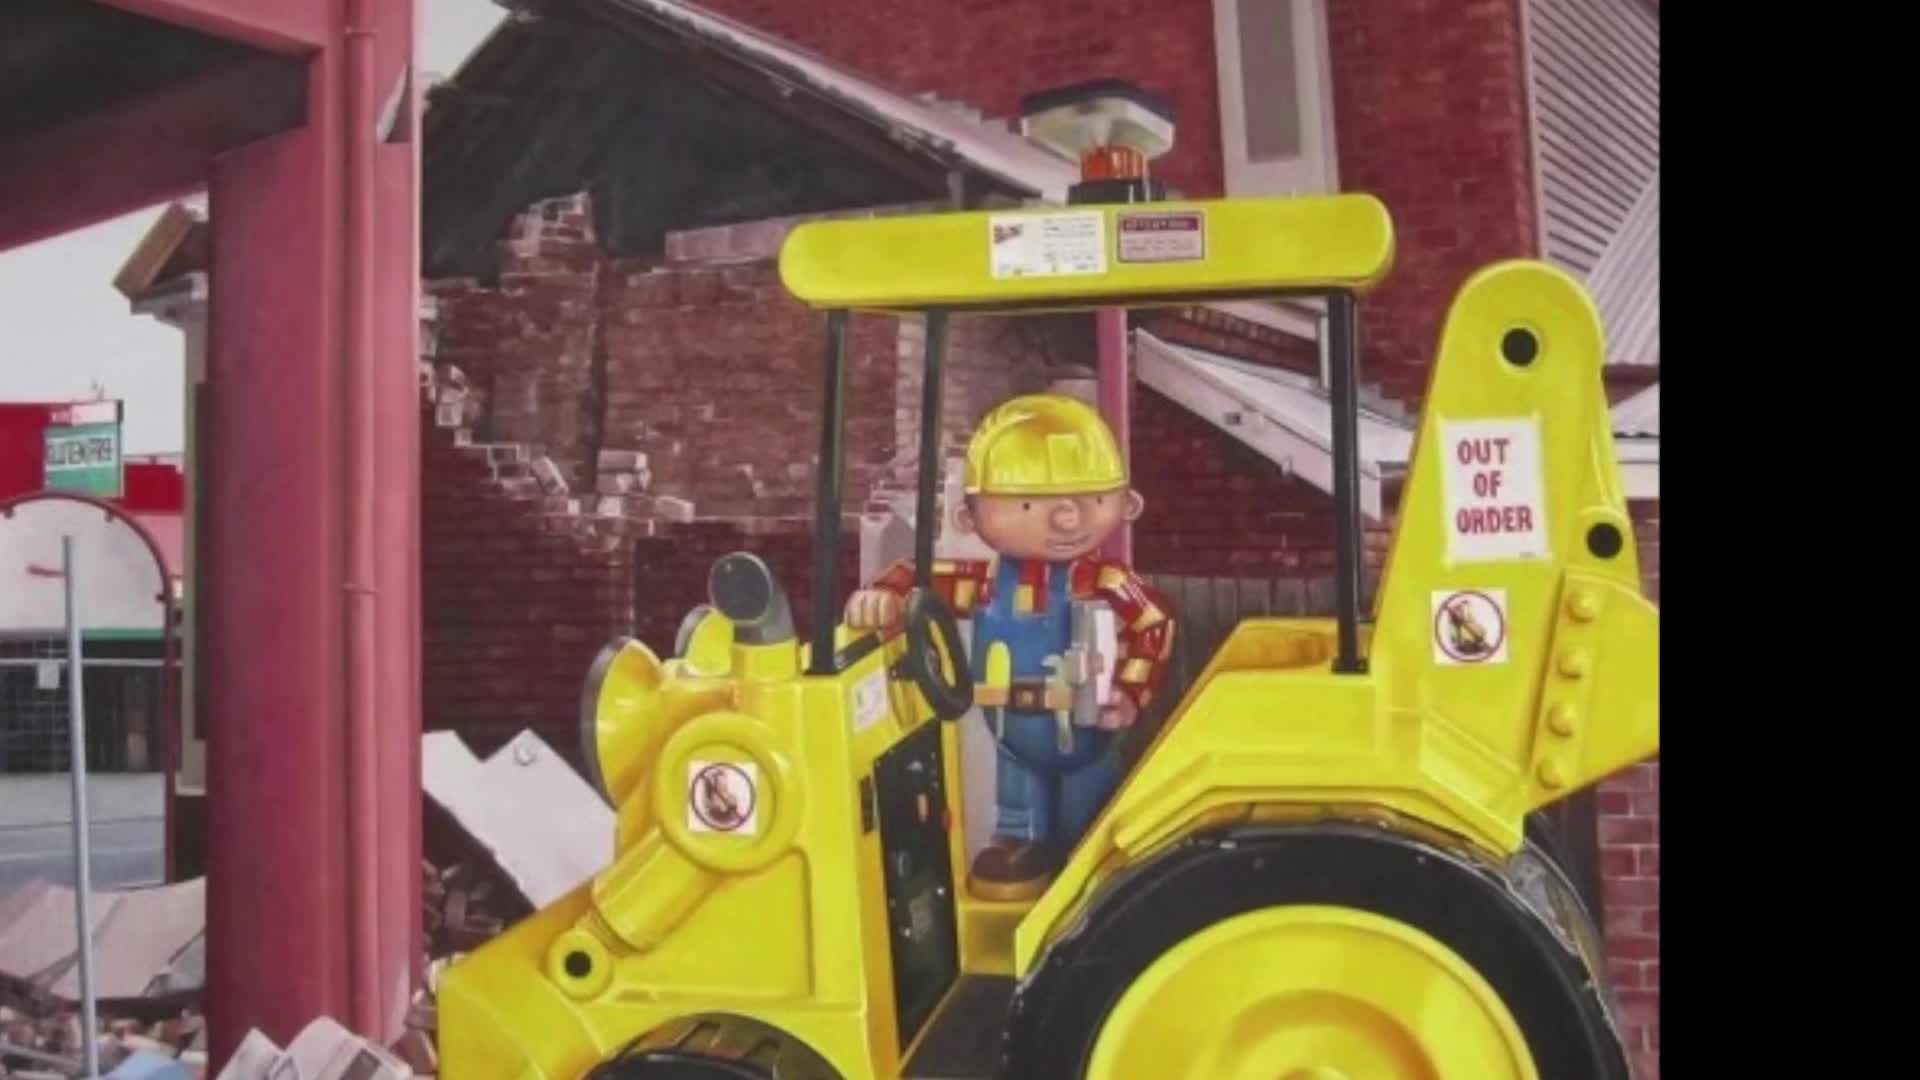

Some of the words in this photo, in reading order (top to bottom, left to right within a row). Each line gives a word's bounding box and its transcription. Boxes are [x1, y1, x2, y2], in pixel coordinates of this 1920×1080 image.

[1456, 437, 1510, 465] OUT
[1473, 470, 1502, 498] OF
[1456, 505, 1533, 534] ORDER
